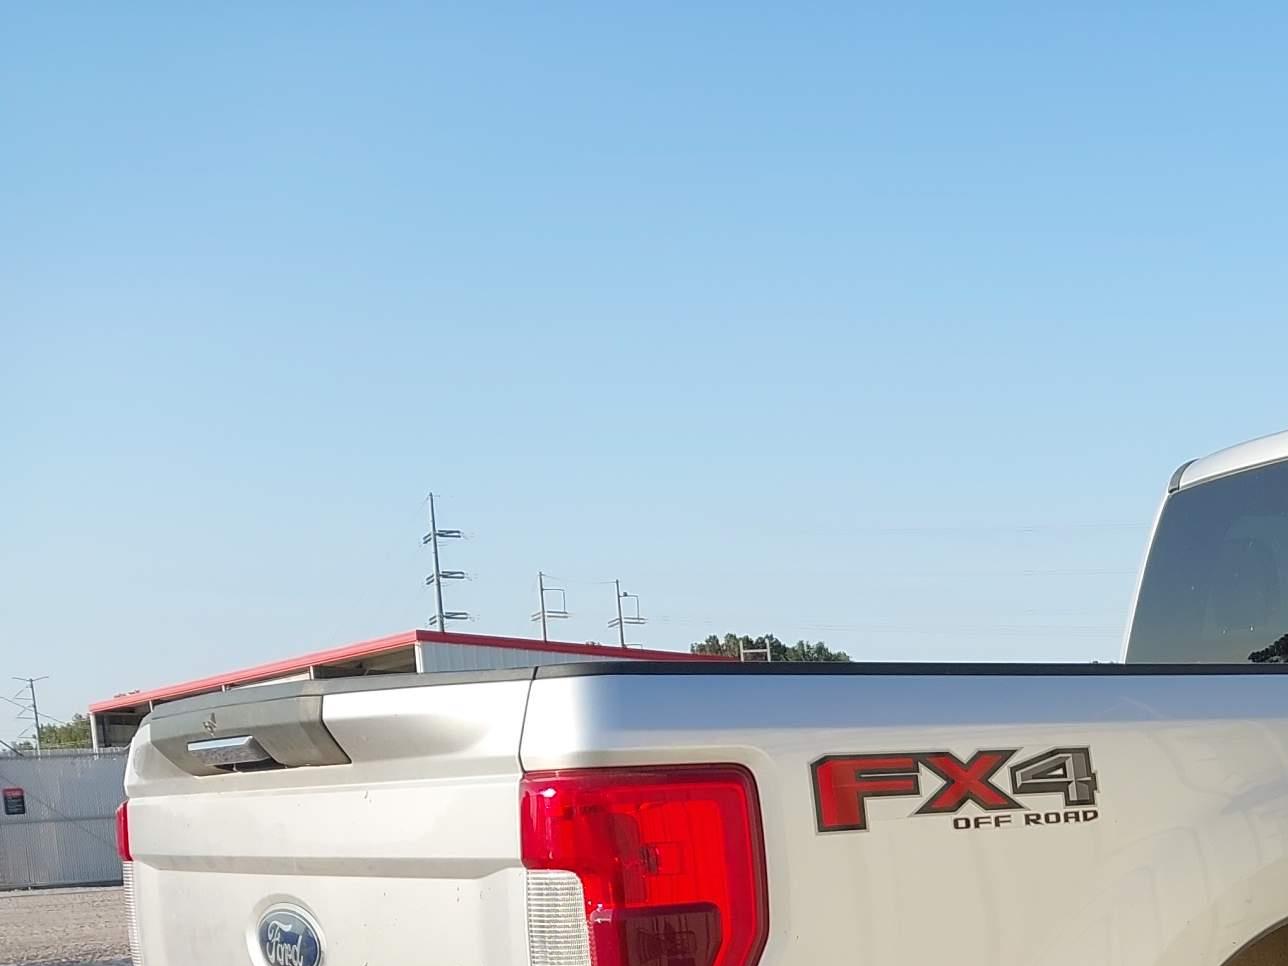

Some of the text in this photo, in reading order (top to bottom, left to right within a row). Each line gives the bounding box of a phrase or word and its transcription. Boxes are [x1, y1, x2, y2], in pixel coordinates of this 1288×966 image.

[810, 747, 1099, 832] FX4
[953, 809, 1099, 831] OFF ROAD
